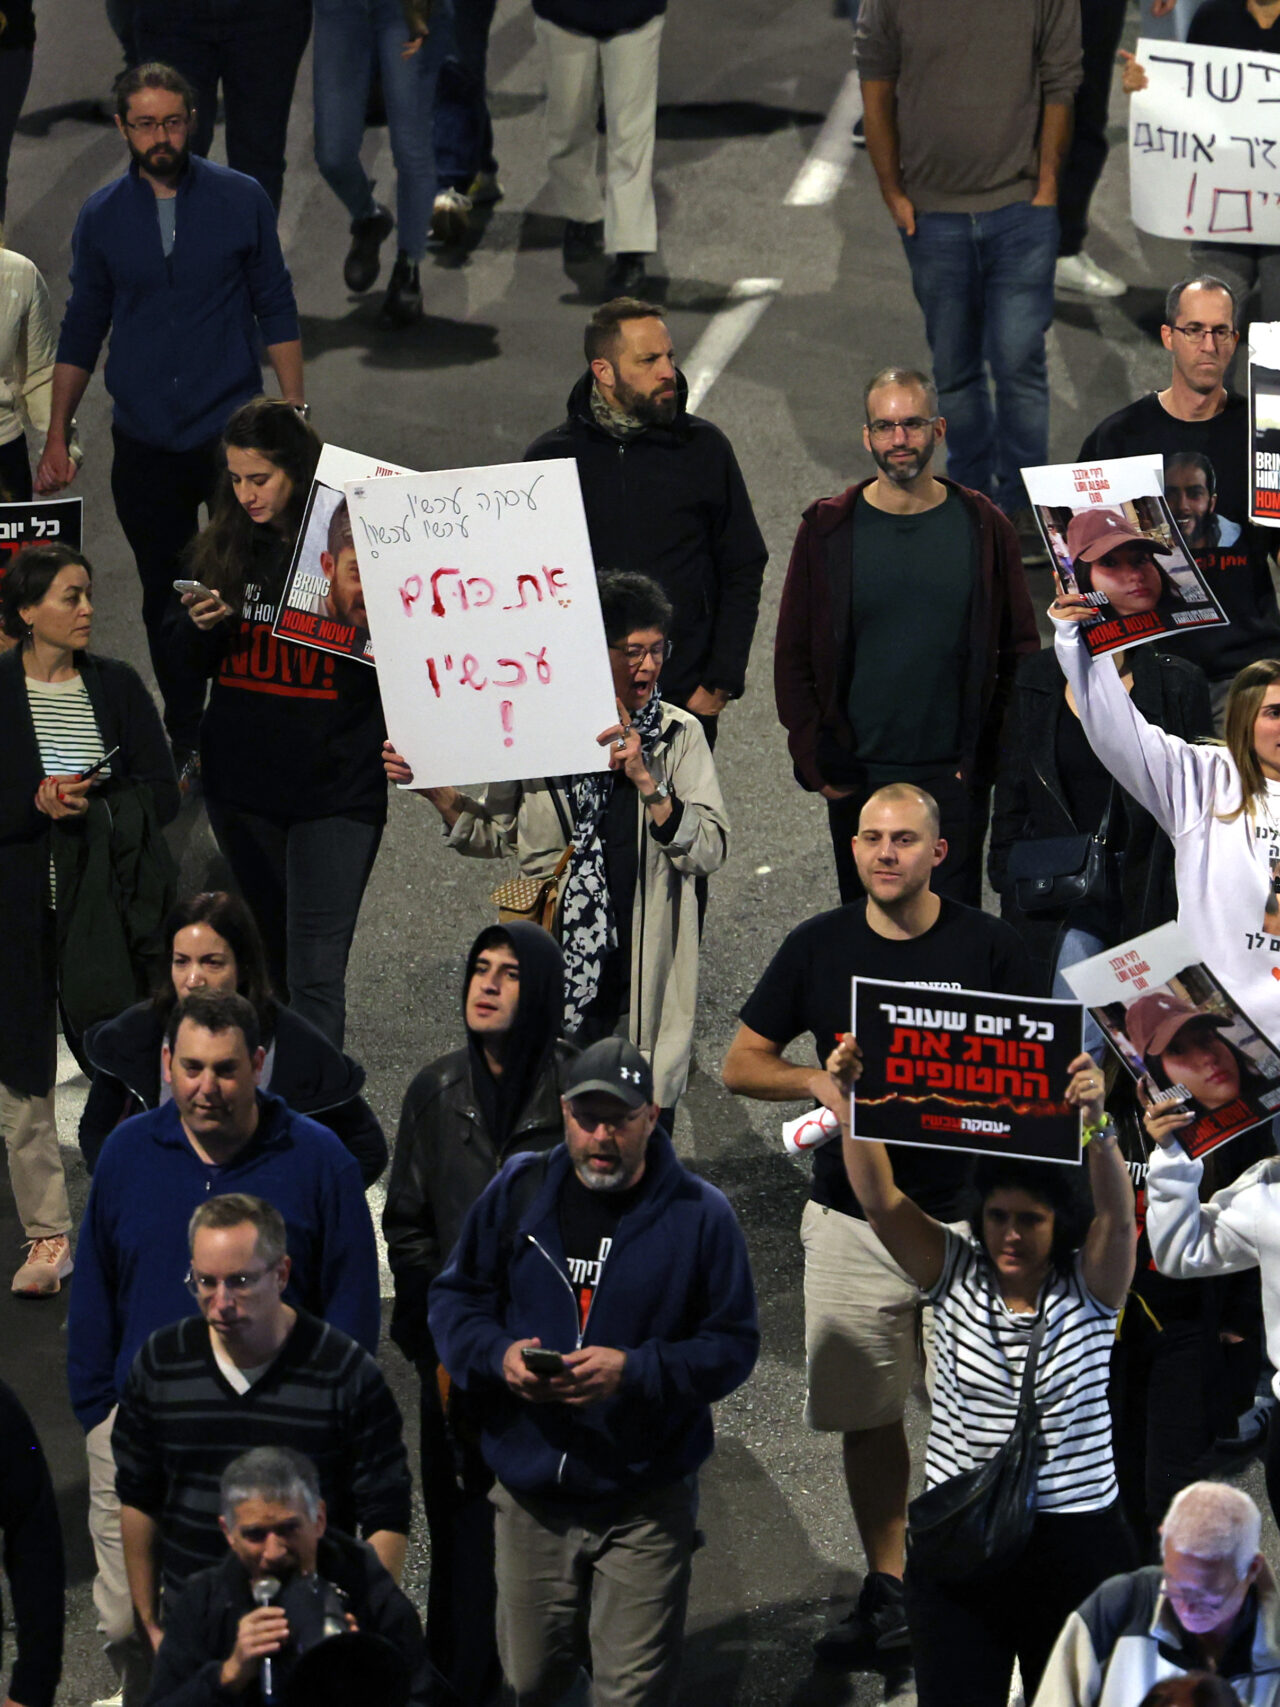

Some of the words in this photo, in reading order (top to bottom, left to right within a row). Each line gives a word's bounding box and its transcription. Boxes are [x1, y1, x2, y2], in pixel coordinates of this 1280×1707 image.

[1133, 122, 1216, 163] אותם
[1255, 471, 1280, 490] HIM
[477, 475, 545, 520] עסקה
[31, 516, 60, 537] כל
[287, 588, 313, 611] HIM
[292, 571, 331, 598] BRING
[502, 565, 568, 610] את
[1083, 591, 1109, 607] ING
[281, 609, 319, 636] HOME
[320, 617, 356, 646] NOW!
[1087, 620, 1125, 647] HOME
[1123, 611, 1162, 634] NOW!
[426, 646, 552, 698] עכשיו
[499, 700, 515, 748] !
[1245, 932, 1267, 950] לך
[879, 1003, 967, 1032] שעובר
[975, 1014, 1011, 1036] יום
[1018, 1014, 1055, 1042] כל
[890, 1027, 951, 1059] את
[962, 1035, 1045, 1069] הורג
[886, 1057, 1049, 1099] החטופים
